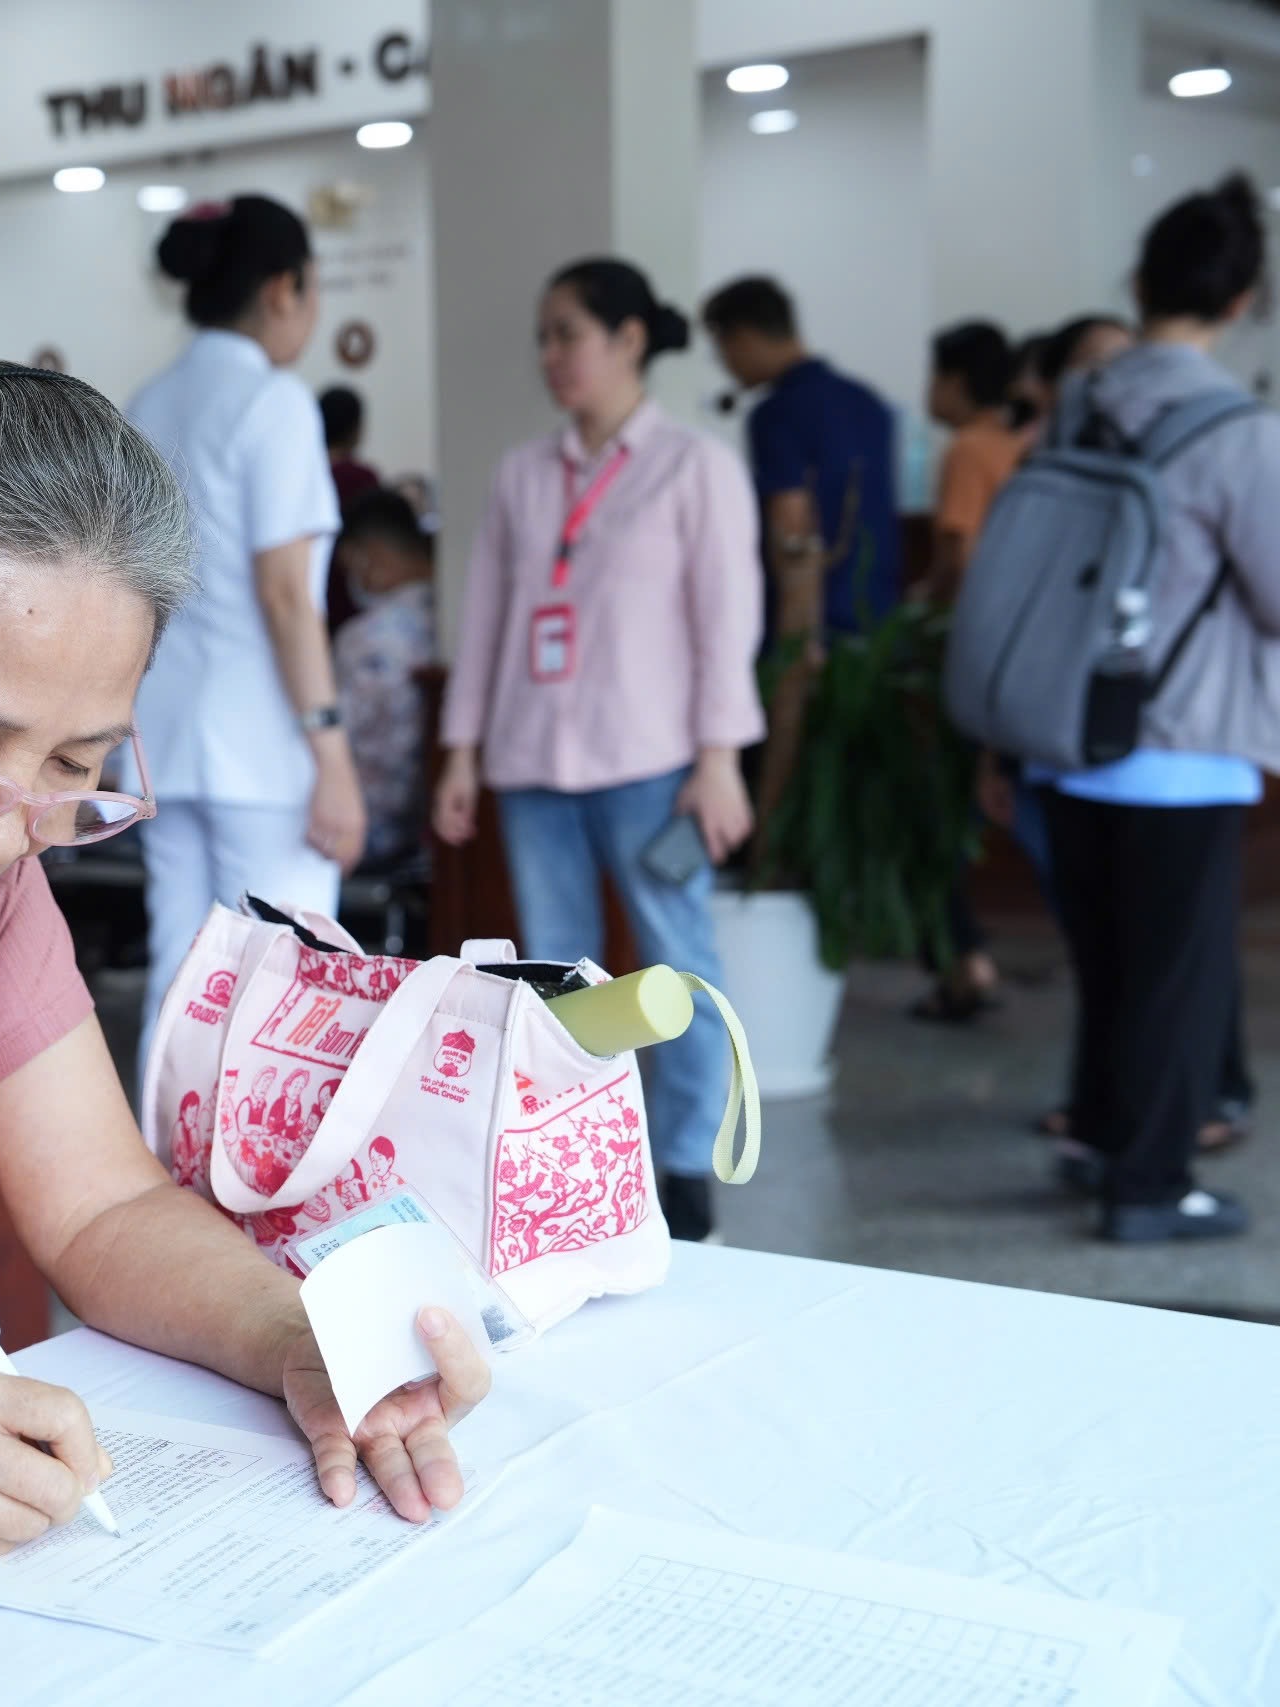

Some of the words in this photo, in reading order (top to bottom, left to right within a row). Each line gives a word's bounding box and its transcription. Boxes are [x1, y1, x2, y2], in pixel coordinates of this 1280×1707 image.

[45, 79, 147, 138] THU
[374, 32, 429, 83] C
[315, 1022, 355, 1056] Sum
[441, 1090, 465, 1104] Group
